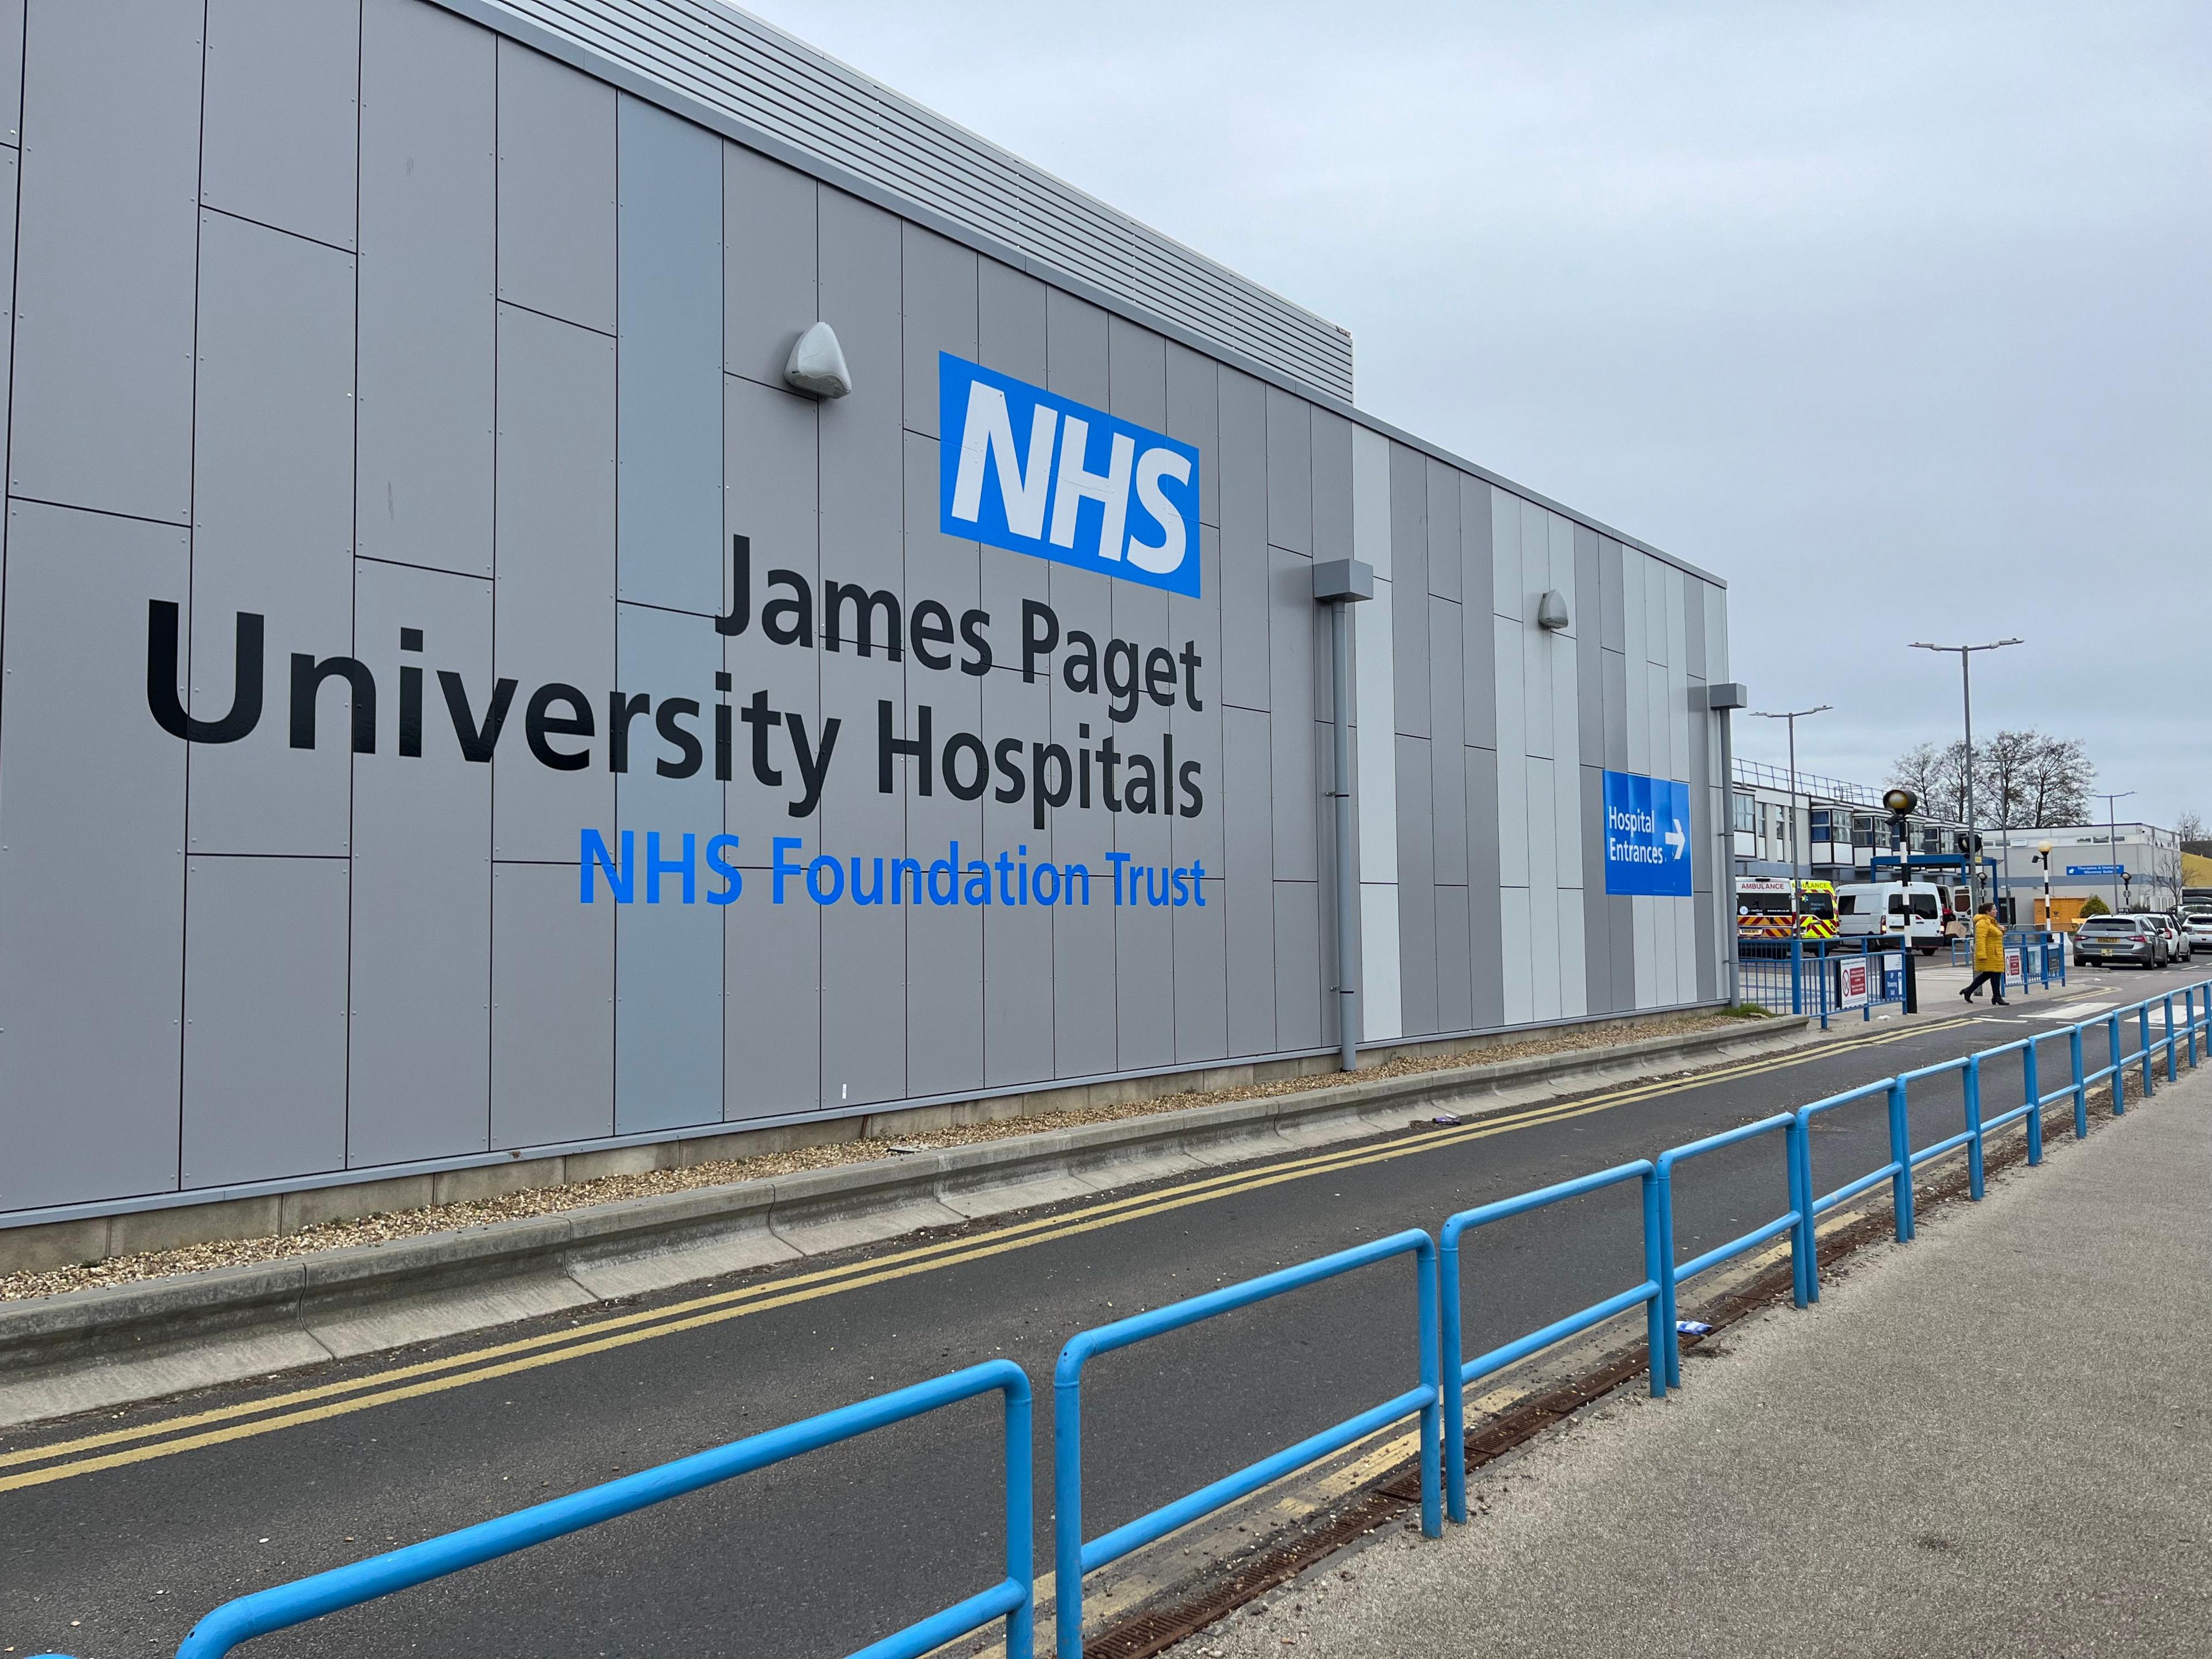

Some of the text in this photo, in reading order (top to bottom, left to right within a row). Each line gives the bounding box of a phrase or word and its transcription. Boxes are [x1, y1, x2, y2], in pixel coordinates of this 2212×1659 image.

[951, 380, 1192, 574] NHS
[715, 533, 1203, 723] James Paget
[147, 599, 1203, 831] University Hospitals
[580, 828, 1206, 907] NHS Foundation Trust
[1608, 805, 1655, 838] Hospital
[1609, 837, 1664, 865] Entrances
